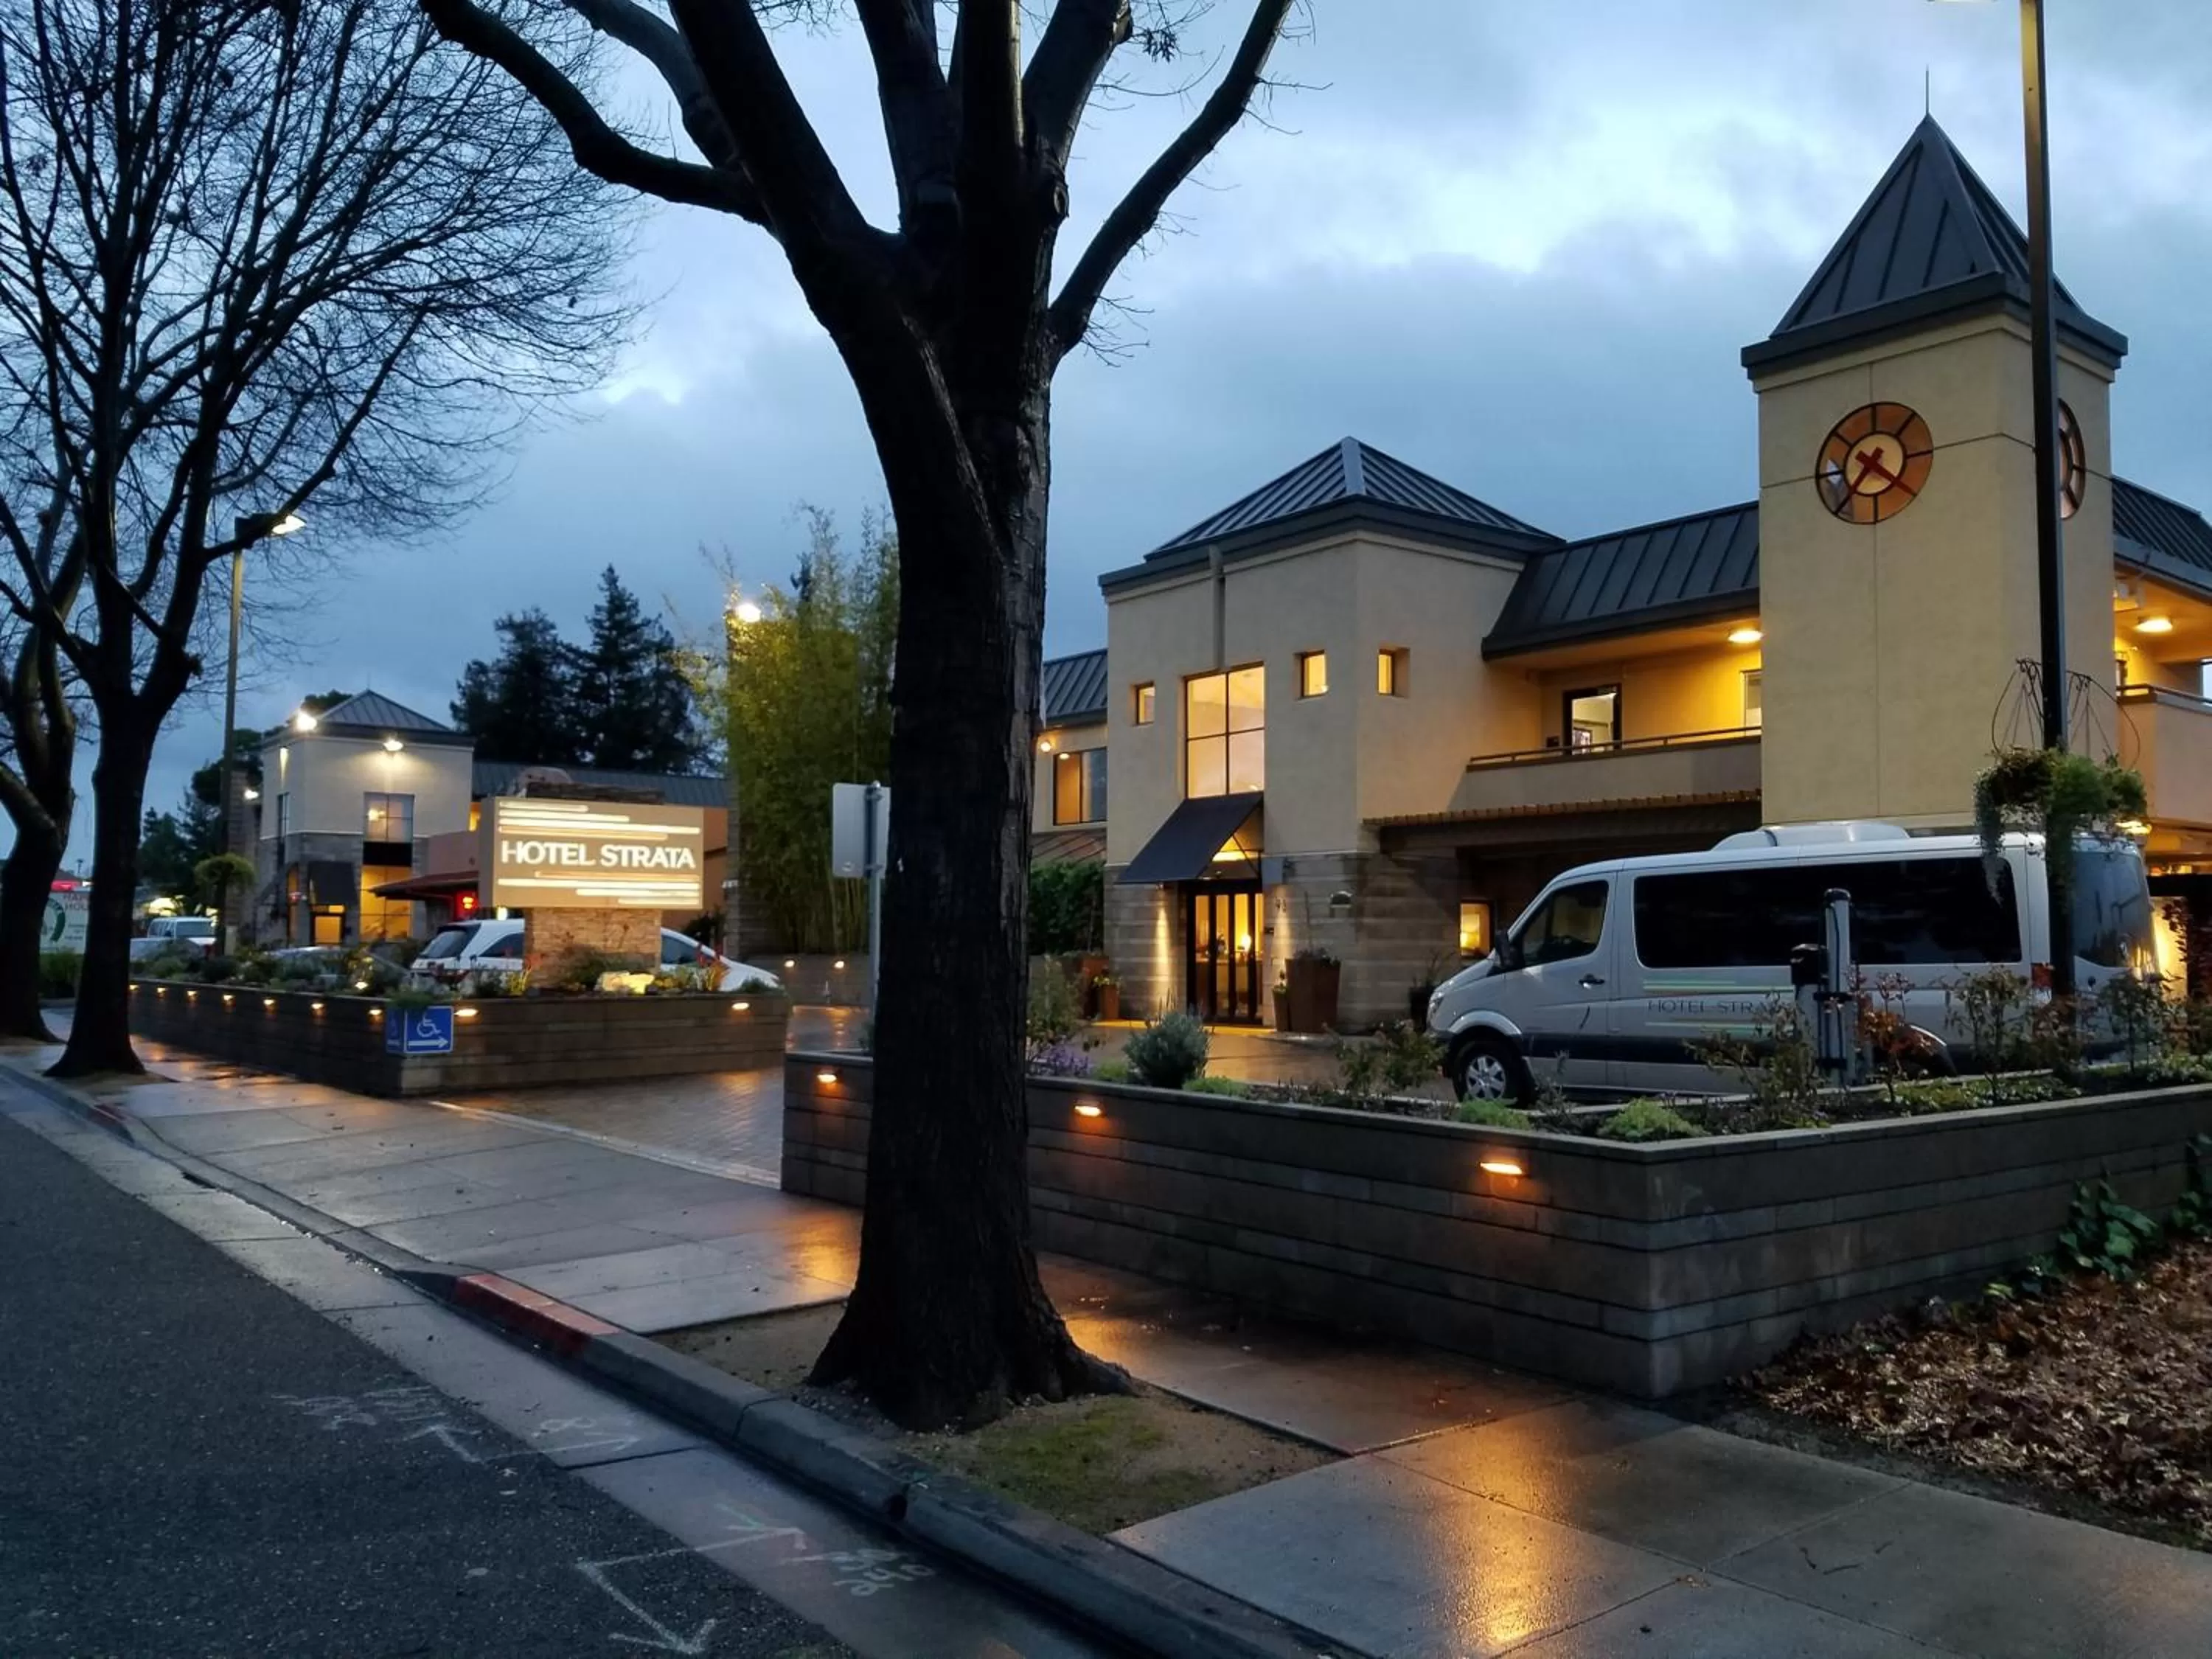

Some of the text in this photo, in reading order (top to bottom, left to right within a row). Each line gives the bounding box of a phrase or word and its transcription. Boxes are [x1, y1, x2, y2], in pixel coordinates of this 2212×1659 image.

[501, 840, 697, 869] HOTEL STRATA
[1647, 999, 1778, 1015] HOTEL STRA
